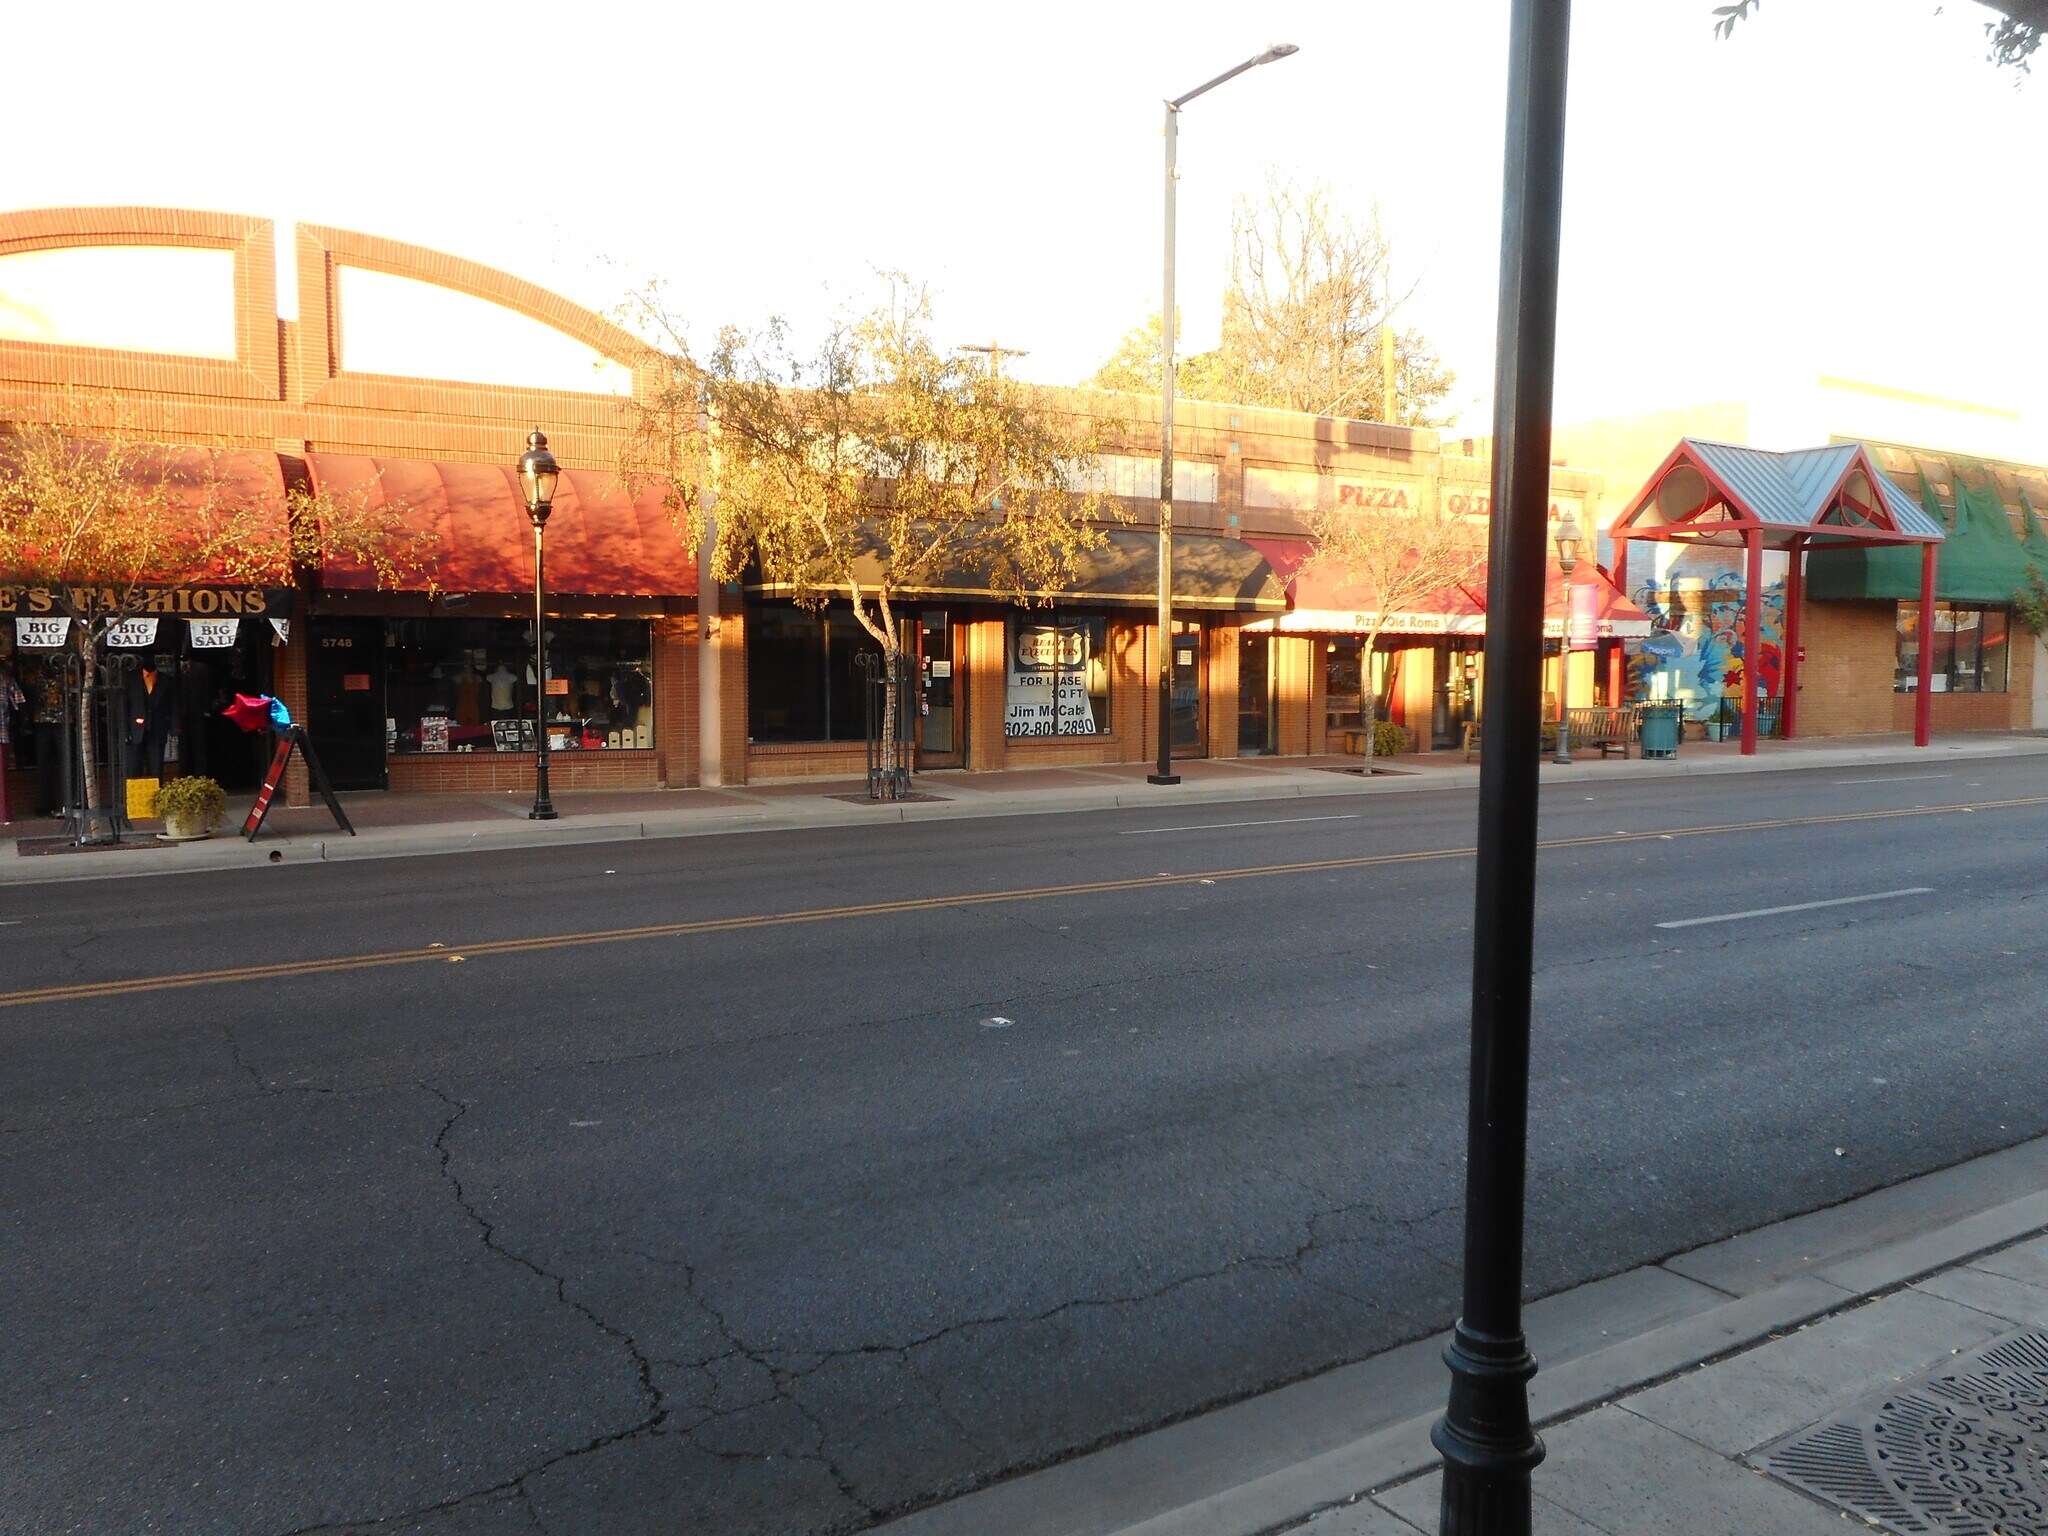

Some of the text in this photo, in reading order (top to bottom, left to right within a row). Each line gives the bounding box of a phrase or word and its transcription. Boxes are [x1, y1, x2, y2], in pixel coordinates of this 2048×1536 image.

[1338, 484, 1409, 509] PIZZA
[72, 587, 266, 613] FASHIONS
[1387, 616, 1405, 627] Old
[1410, 616, 1439, 628] Roma
[28, 623, 60, 633] BIG
[119, 624, 149, 634] BIG
[200, 625, 231, 635] BIG
[21, 634, 66, 645] SALE
[111, 634, 154, 645] SALE
[322, 638, 352, 647] 5748
[1021, 647, 1079, 657] EXECUIVES
[1020, 676, 1082, 686] FOR LASE
[1070, 689, 1083, 699] FT
[1010, 705, 1034, 717] Jim
